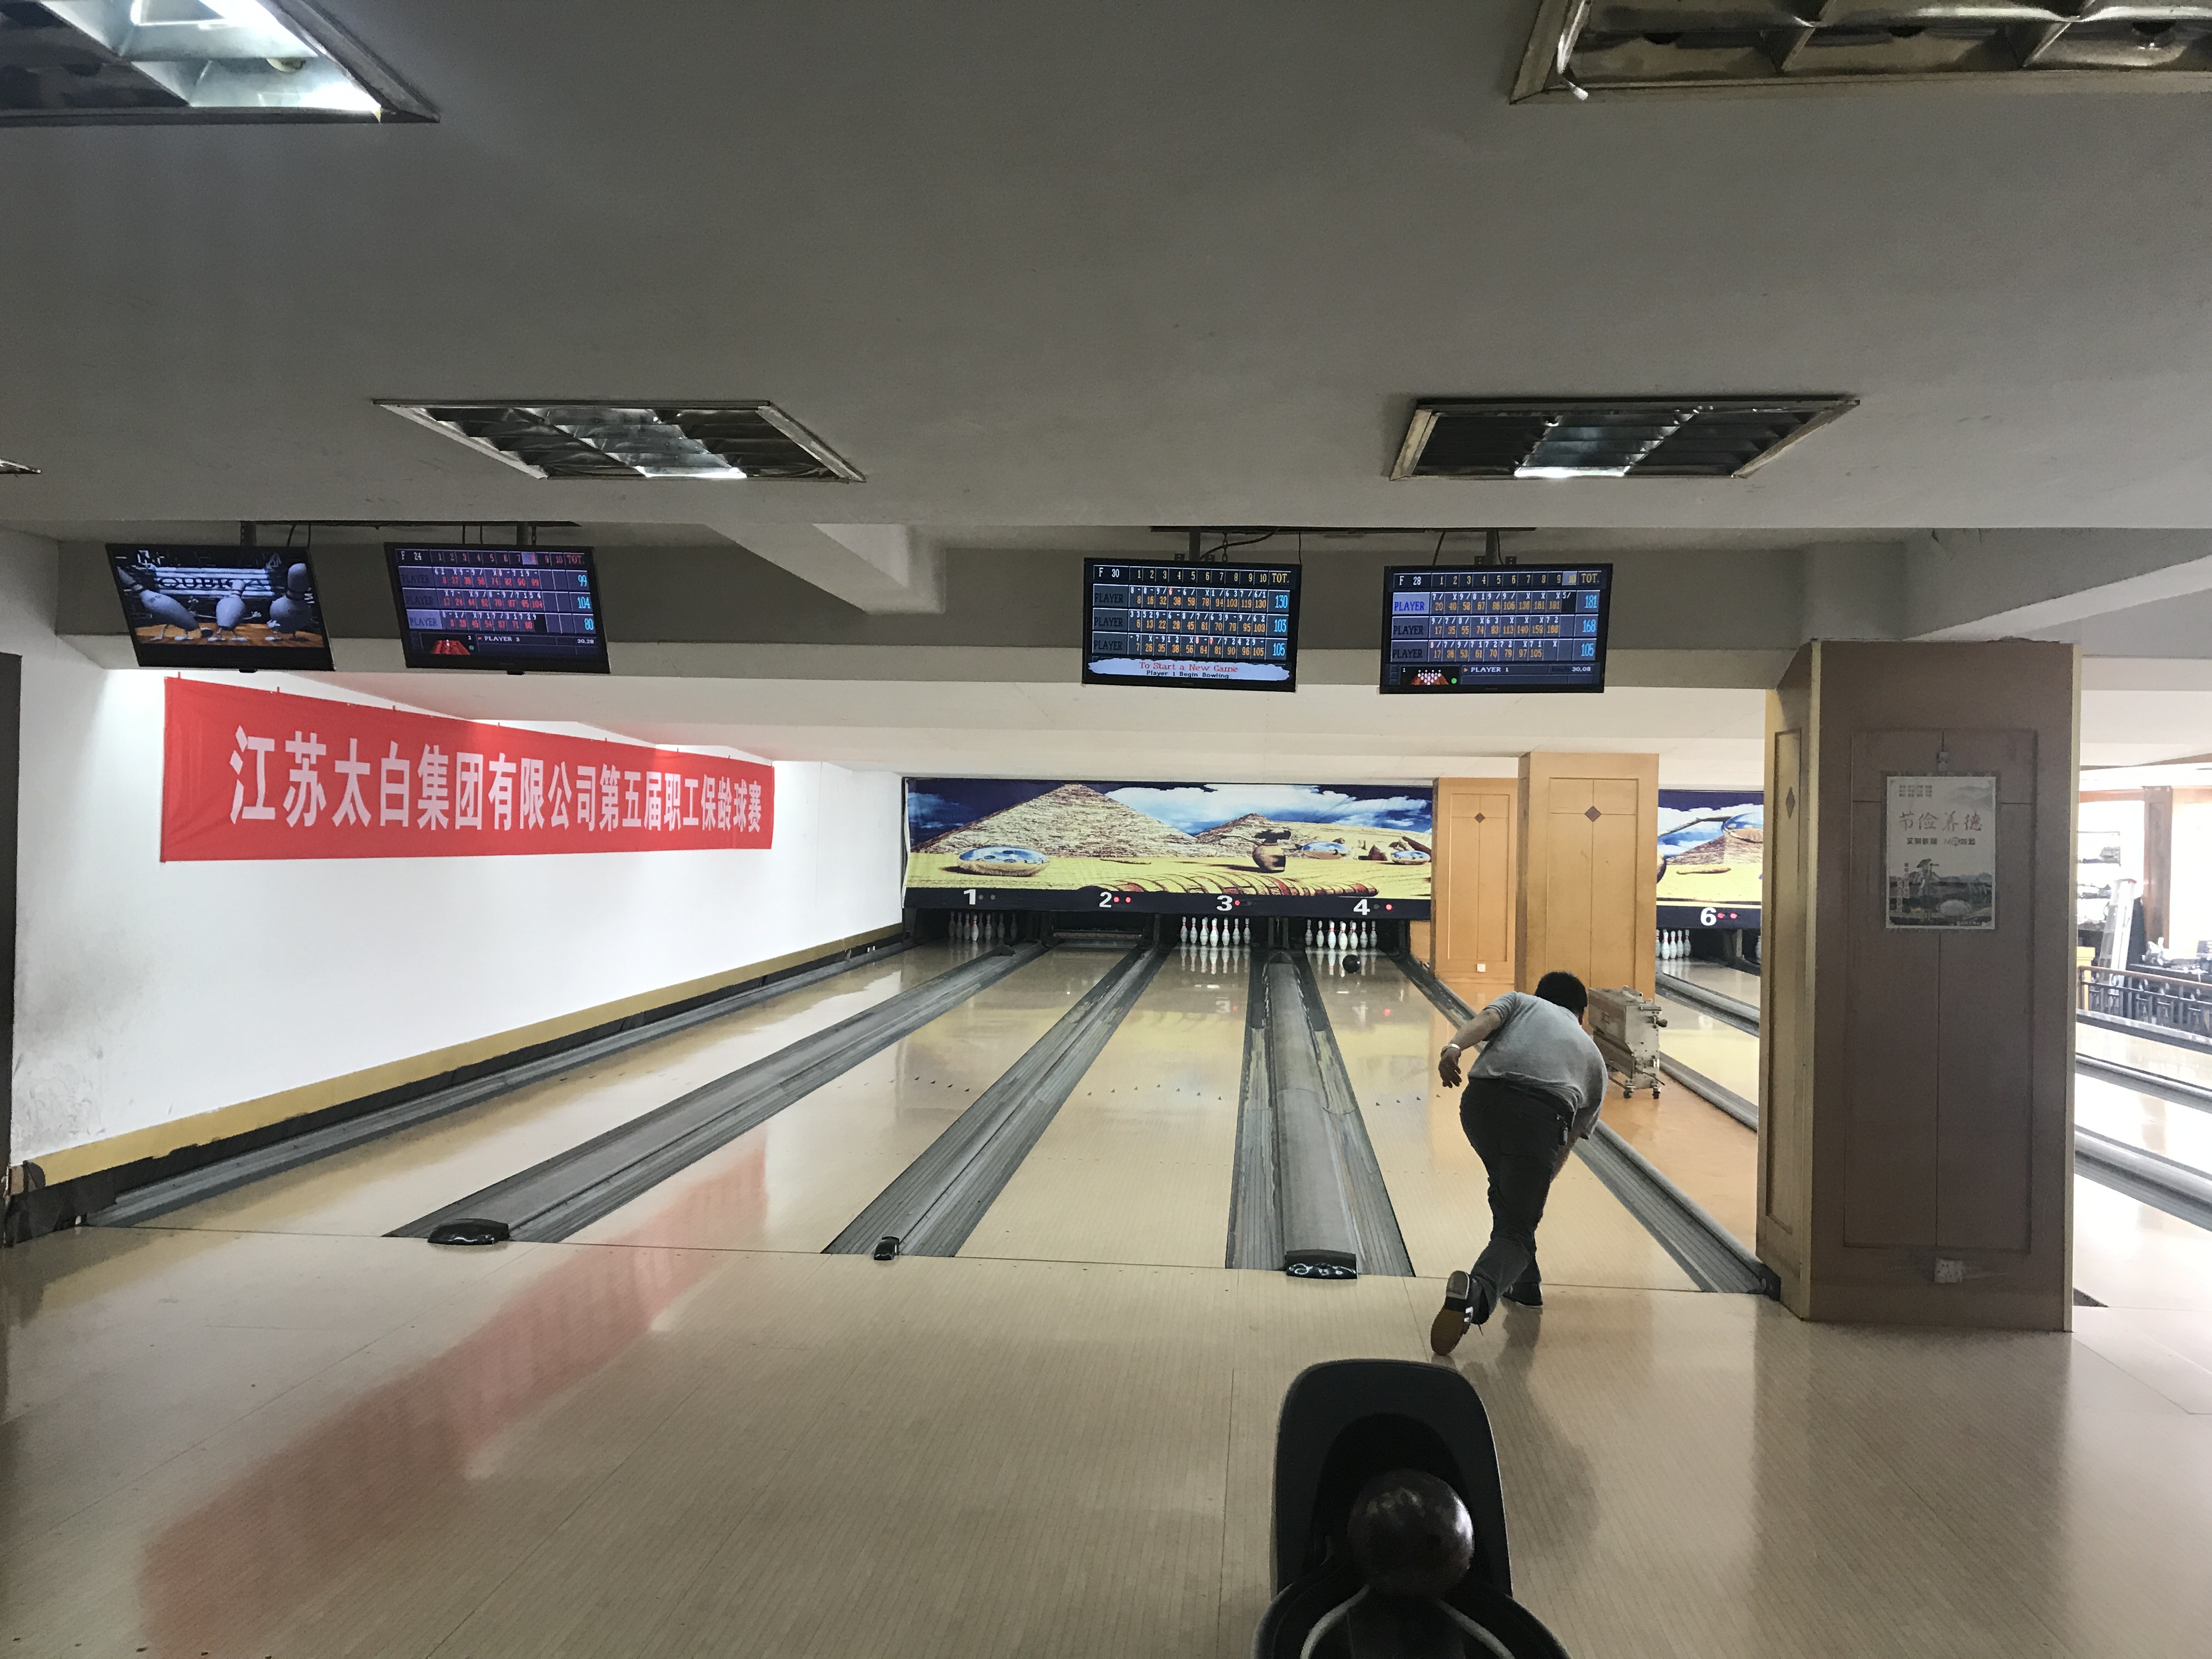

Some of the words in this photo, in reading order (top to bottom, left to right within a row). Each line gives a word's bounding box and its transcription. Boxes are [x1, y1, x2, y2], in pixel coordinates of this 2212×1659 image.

[402, 575, 429, 583] PLAYER
[578, 575, 587, 586] 99
[1099, 568, 1103, 577] F
[1111, 569, 1119, 577] 30
[1138, 570, 1141, 578] 1
[1150, 570, 1154, 578] 2
[1163, 571, 1167, 579] 3
[1177, 571, 1181, 579] 4
[1191, 572, 1195, 580] 5
[1206, 572, 1209, 580] 6
[1220, 573, 1223, 581] 7
[1234, 573, 1238, 582] 8
[1249, 573, 1252, 582] 9
[1260, 574, 1266, 582] 10
[1272, 573, 1289, 583] TOT.
[1400, 576, 1404, 585] F
[1413, 577, 1421, 585] 28
[1440, 577, 1443, 585] 1
[1453, 576, 1457, 585] 2
[1467, 576, 1471, 584] 3
[1482, 575, 1486, 584] 4
[1497, 575, 1501, 584] 5
[1511, 575, 1516, 584] 6
[1527, 575, 1531, 583] 7
[1542, 575, 1545, 583] 8
[1557, 575, 1561, 583] 9
[1568, 575, 1576, 583] 10
[1582, 573, 1599, 583] TOT.
[406, 597, 433, 605] PLAYER
[578, 597, 590, 609] 104
[1094, 593, 1123, 603] PLAYER
[1147, 596, 1154, 605] 16
[1160, 596, 1167, 605] 32
[1173, 597, 1181, 605] 38
[1188, 597, 1195, 606] 58
[1202, 597, 1209, 606] 78
[1216, 599, 1223, 607] 94
[1227, 599, 1237, 607] 103
[1242, 599, 1251, 608] 119
[1255, 600, 1266, 608] 130
[1275, 595, 1288, 608] 130
[1394, 601, 1424, 611] PLAYER
[1435, 602, 1443, 611] 20
[1584, 595, 1597, 608] 181
[410, 617, 437, 627] PLAYER
[584, 618, 594, 630] 80
[1094, 617, 1122, 627] PLAYER
[1147, 620, 1153, 628] 13
[1159, 620, 1166, 629] 22
[1187, 621, 1194, 630] 45
[1201, 622, 1207, 630] 61
[1215, 622, 1222, 631] 70
[1229, 623, 1237, 631] 79
[1243, 623, 1250, 631] 95
[1254, 623, 1265, 633] 103
[1274, 619, 1286, 632] 103
[1393, 625, 1423, 634] PLAYER
[1462, 626, 1469, 634] 55
[1476, 626, 1483, 634] 74
[1517, 625, 1528, 634] 140
[1582, 619, 1596, 632] 168
[1094, 640, 1122, 650] PLAYER
[1146, 644, 1152, 652] 26
[1158, 644, 1165, 652] 35
[1172, 645, 1179, 653] 38
[1186, 645, 1193, 653] 56
[1227, 647, 1235, 655] 90
[1253, 647, 1264, 656] 105
[1273, 643, 1285, 656] 105
[1393, 649, 1423, 658] PLAYER
[1434, 650, 1441, 658] 17
[1505, 650, 1512, 658] 79
[1519, 649, 1527, 657] 97
[1581, 644, 1594, 656] 105
[229, 725, 761, 832] 江苏太白集团有限公司第五届职工保龄球赛
[1899, 810, 1982, 831] 节俭养德
[963, 889, 976, 905] 1
[1099, 891, 1112, 907] 2
[1216, 895, 1233, 911] 3
[1353, 899, 1370, 915] 4
[1701, 907, 1717, 926] 6
